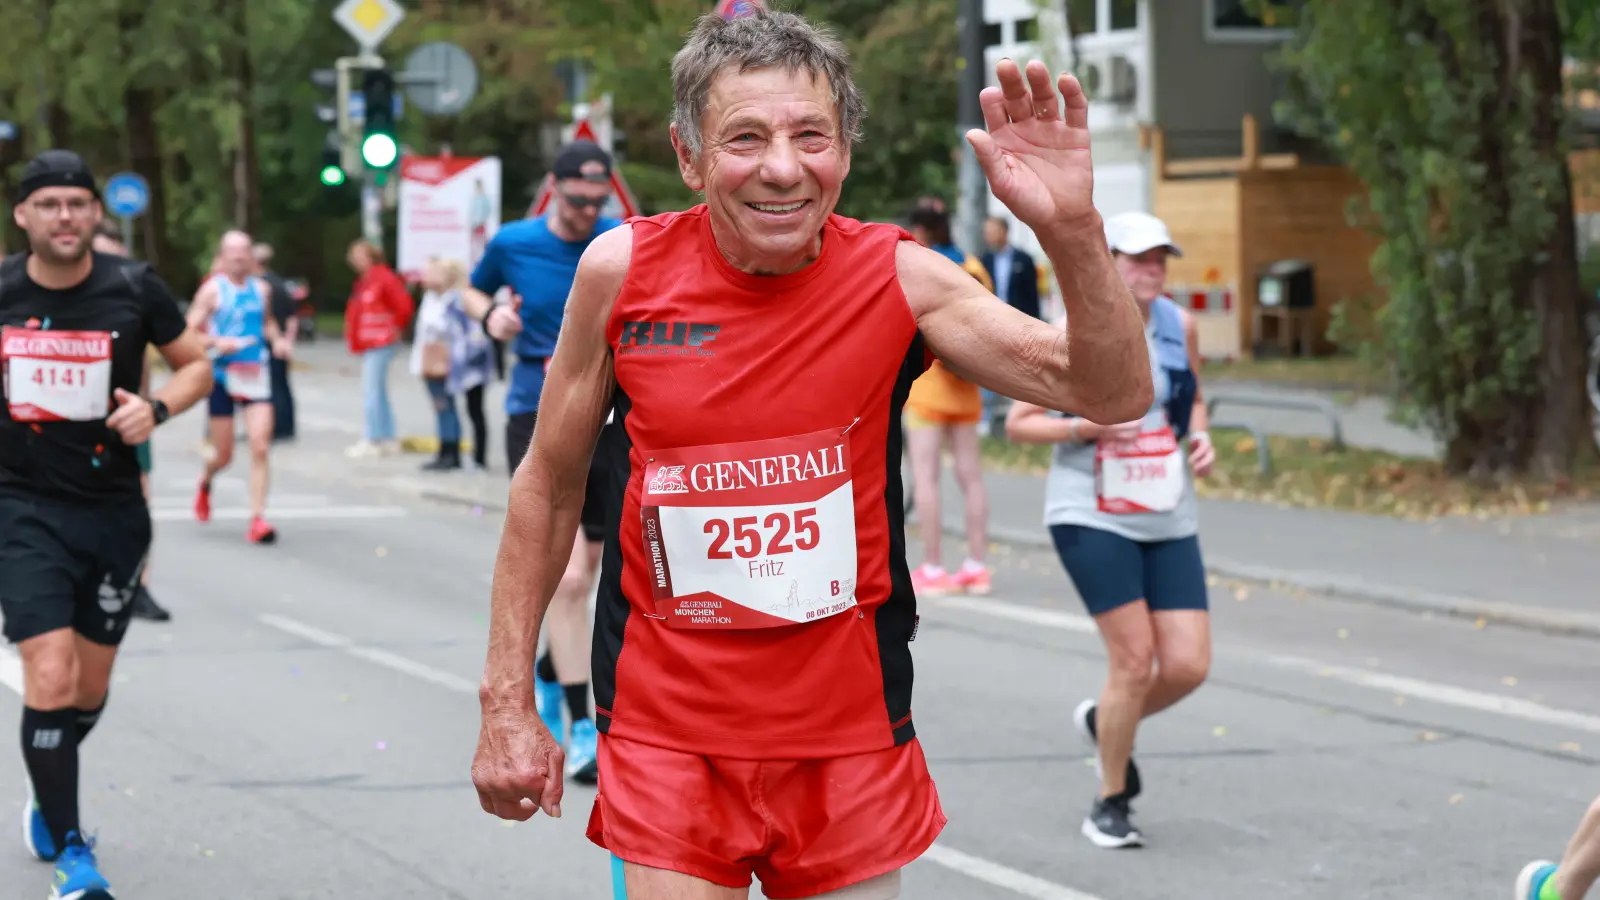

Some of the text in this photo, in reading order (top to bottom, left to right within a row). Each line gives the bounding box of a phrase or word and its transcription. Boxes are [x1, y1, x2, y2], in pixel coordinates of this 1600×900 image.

[620, 321, 720, 346] RUF
[31, 367, 85, 387] 4141
[690, 444, 846, 493] GENERALI
[703, 507, 820, 560] 2525
[647, 518, 667, 588] MARATHON 2023
[749, 560, 785, 579] Fritz
[830, 579, 841, 597] B
[690, 601, 723, 609] GENERALI
[806, 602, 847, 619] 08 OKT 2023
[691, 616, 732, 624] MARATHON
